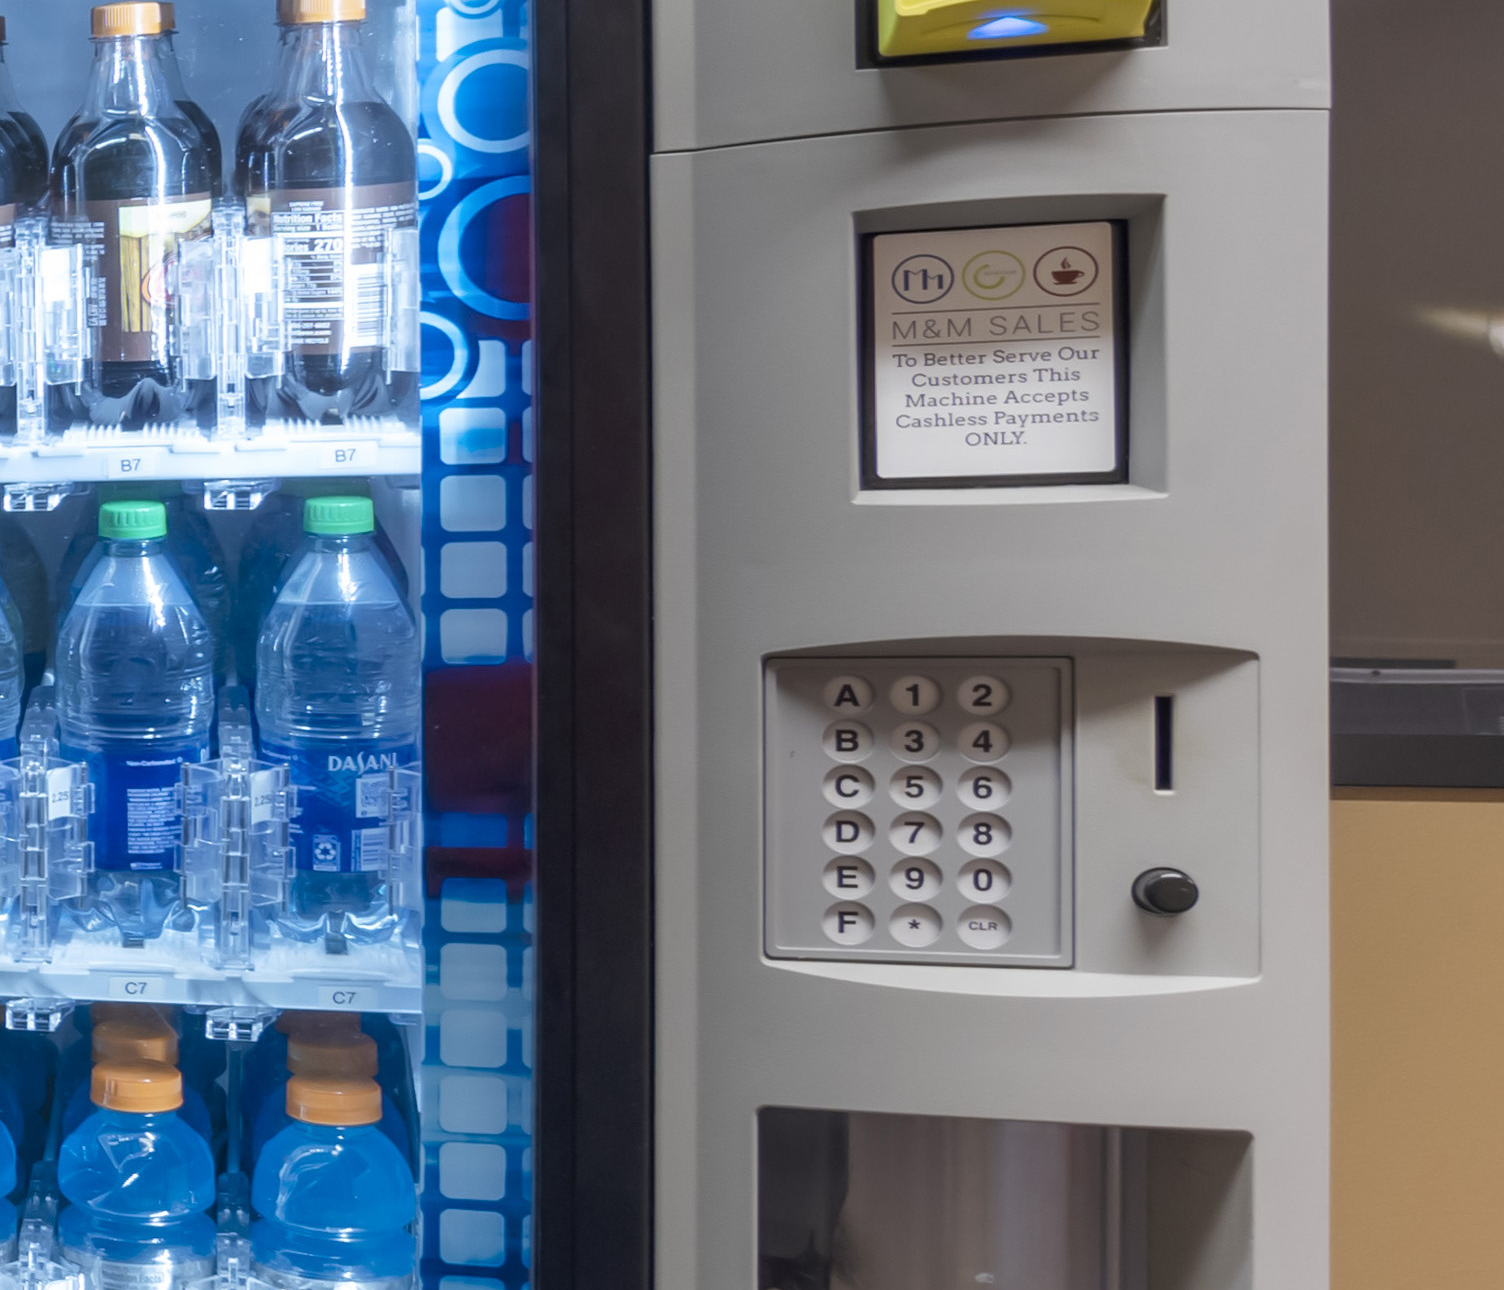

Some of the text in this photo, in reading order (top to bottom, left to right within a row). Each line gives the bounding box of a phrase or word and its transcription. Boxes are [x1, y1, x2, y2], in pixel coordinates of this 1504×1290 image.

[892, 311, 1100, 340] M&M SALES
[892, 346, 1100, 368] To Better Serve Our
[911, 367, 1081, 388] Customers This
[905, 390, 1090, 408] Machine Accepts
[895, 409, 1100, 429] Cashless Payments
[965, 431, 1027, 447] ONLY.
[834, 683, 993, 707] A 1 2
[835, 729, 993, 752] B 3 4
[328, 752, 399, 773] DASANI
[835, 775, 992, 799] C 5 6
[835, 820, 992, 846] D 7 8
[837, 867, 992, 892] E 9 0
[837, 911, 998, 933] F CLR
